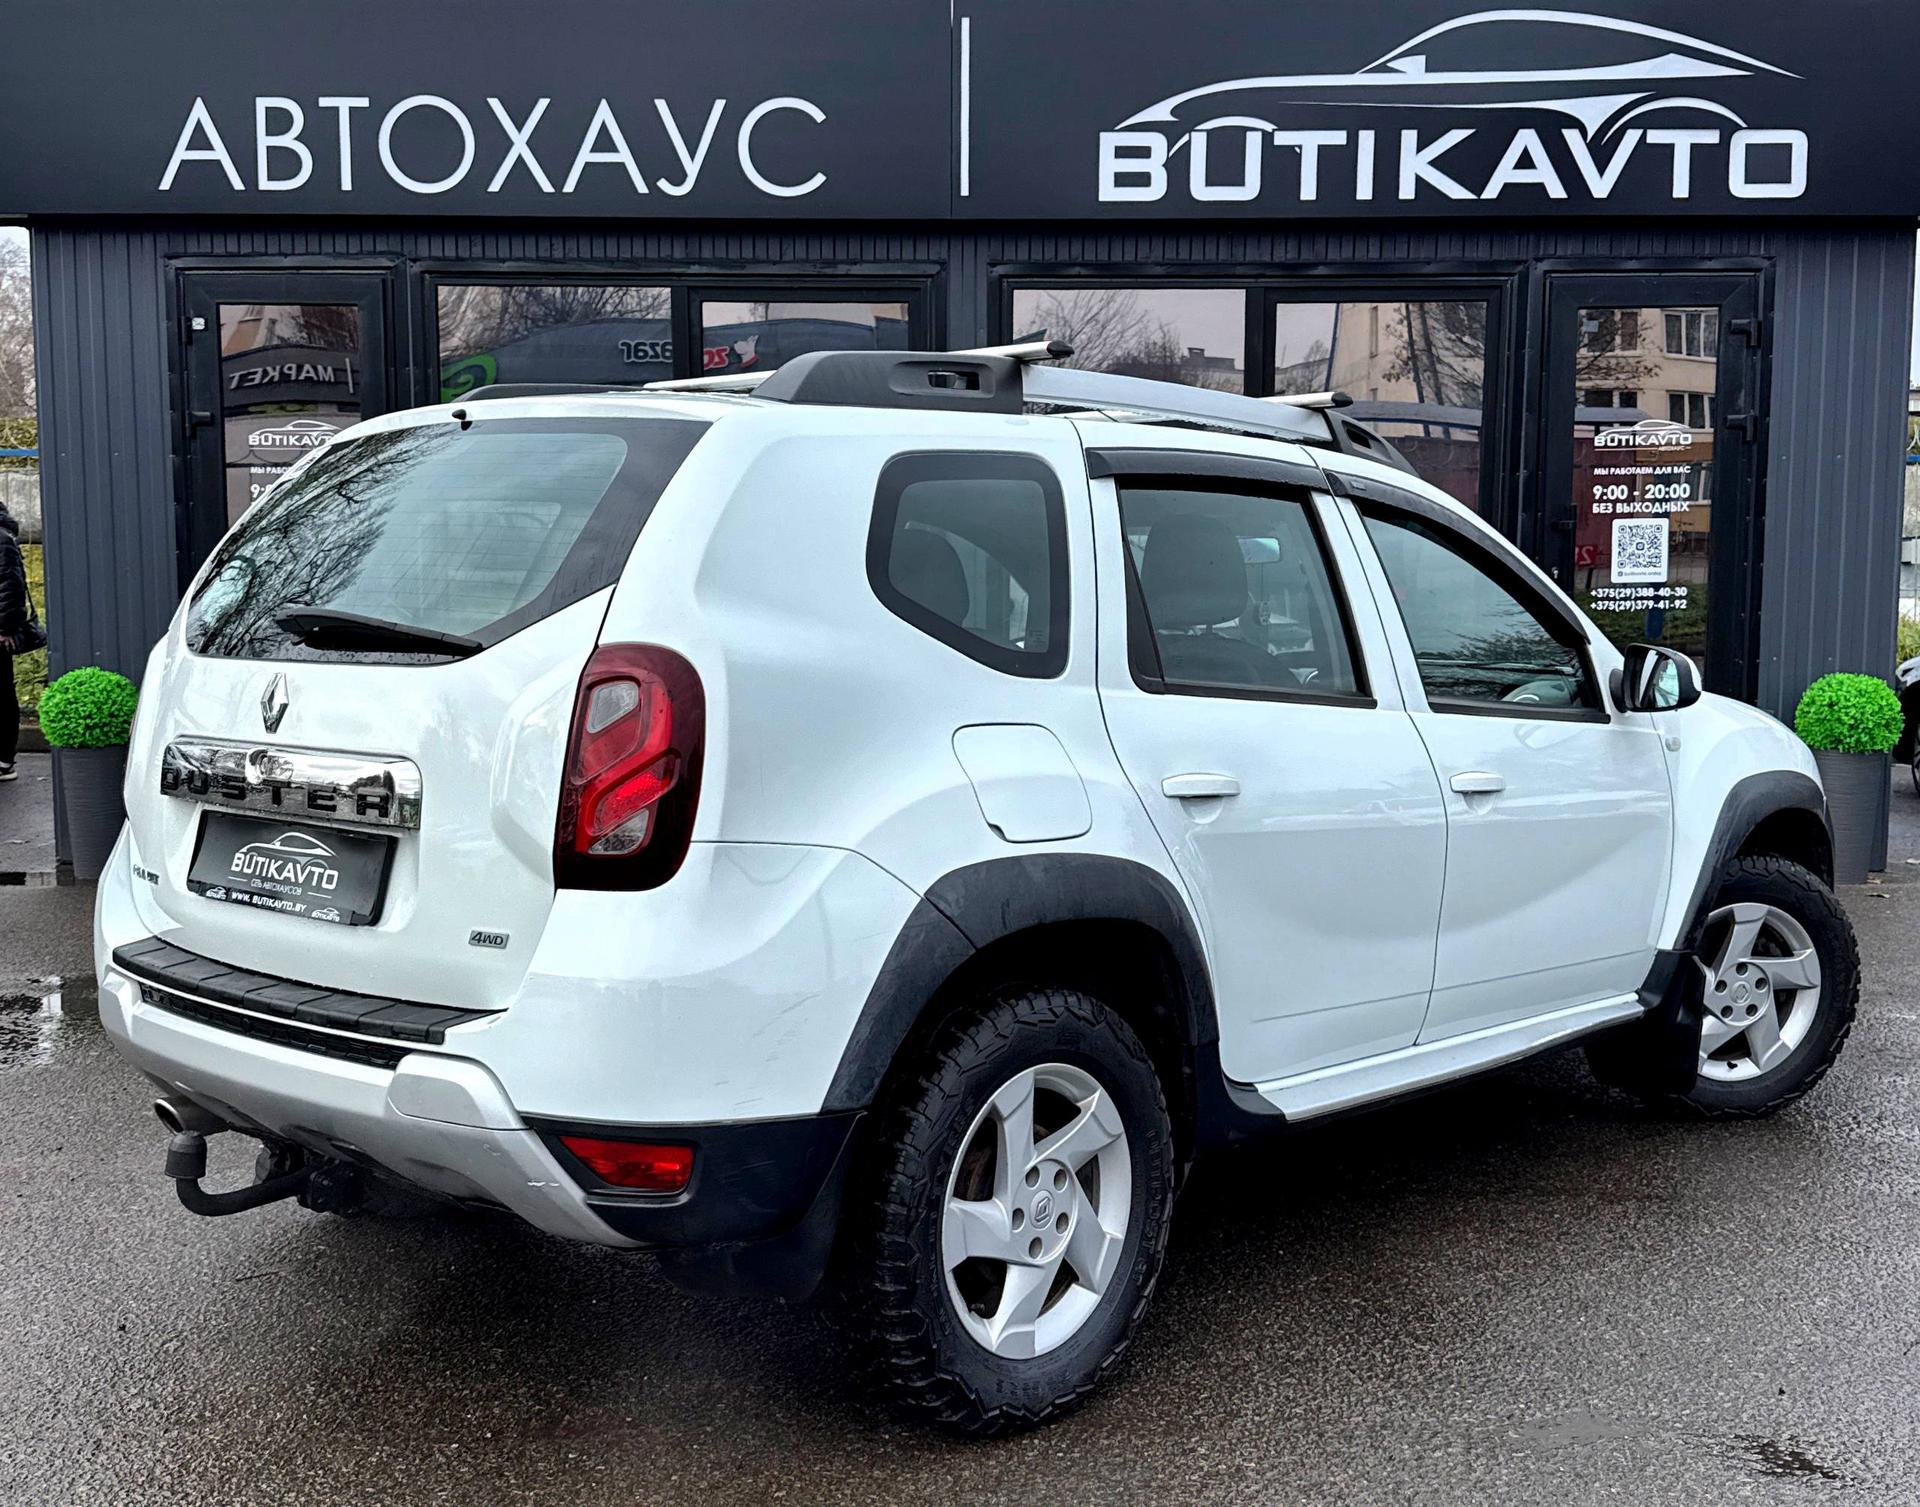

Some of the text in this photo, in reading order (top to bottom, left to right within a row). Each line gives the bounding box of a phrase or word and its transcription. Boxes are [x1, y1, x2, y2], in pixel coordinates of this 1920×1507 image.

[159, 95, 827, 197] АВТОХАУС
[1099, 128, 1809, 202] BUTIKAVTO
[1594, 433, 1692, 447] BUTIKAVTO
[250, 466, 290, 474] МЫ РАБО
[1594, 465, 1691, 476] МЫ РАБОТАЕМ ДЛЯ ВАС
[1592, 484, 1628, 500] 9:00
[1644, 483, 1691, 499] 20:00
[1592, 501, 1690, 514] БЕЗ ВЫХОДНЫХ
[1590, 587, 1688, 600] +375(29)388-40-30
[1590, 599, 1687, 612] +375(29)379-41-92
[160, 766, 390, 819] DUSTER
[231, 852, 339, 890] BUTIKAVTO
[252, 895, 307, 913] BUTIKAVTO.BY
[471, 931, 504, 946] 4WD
